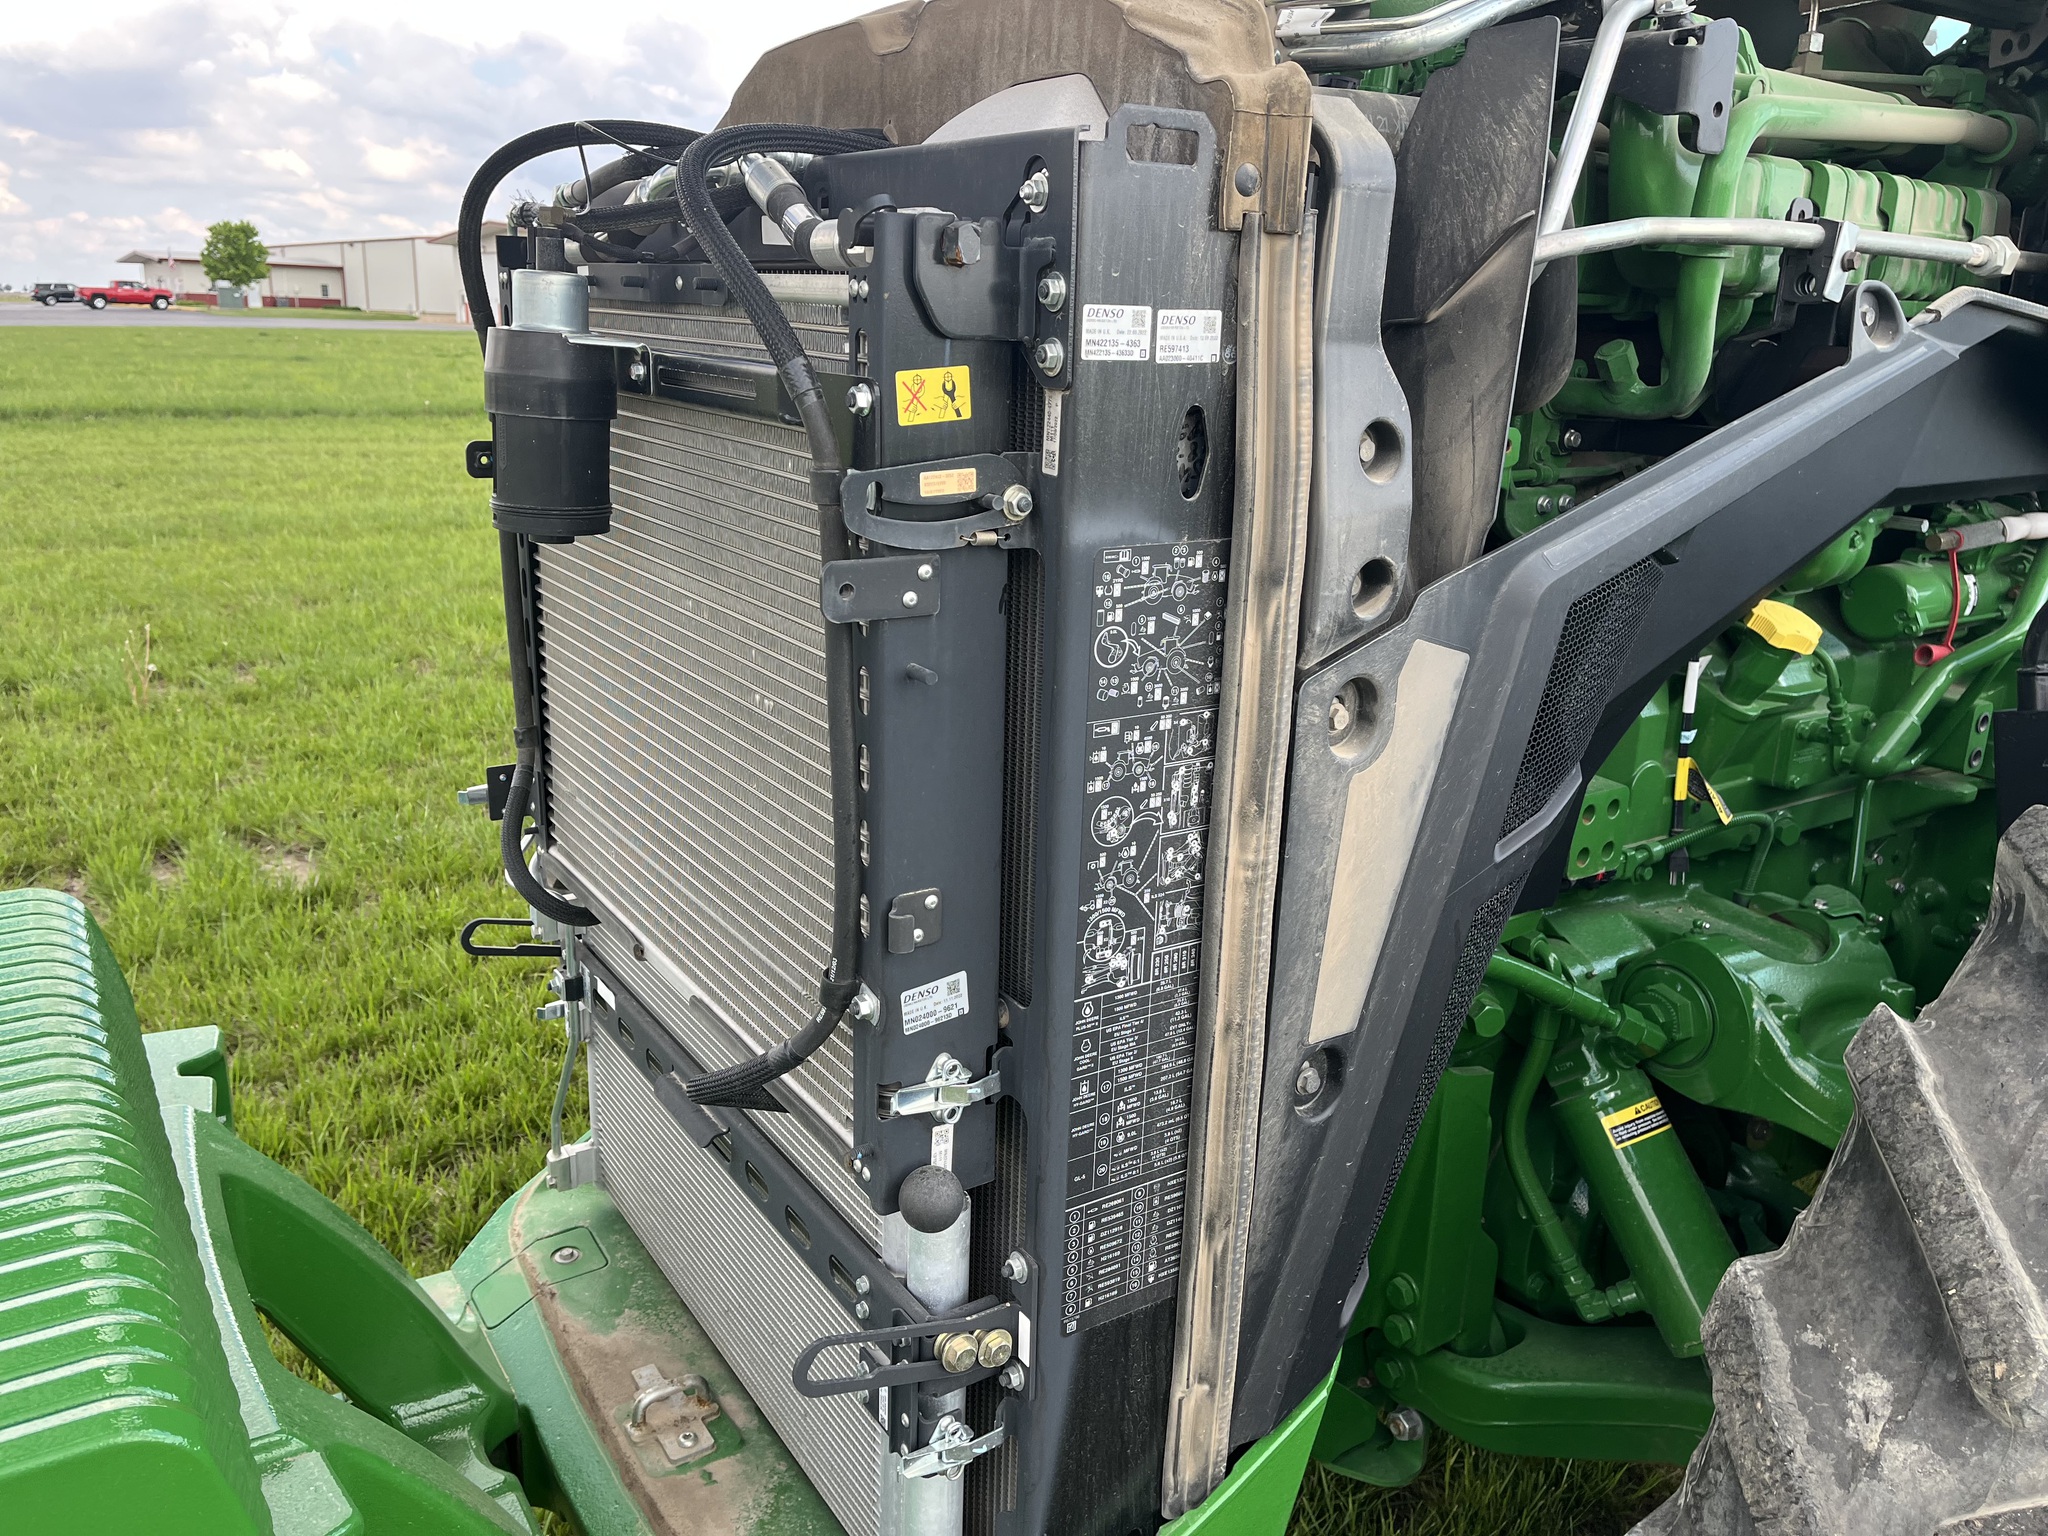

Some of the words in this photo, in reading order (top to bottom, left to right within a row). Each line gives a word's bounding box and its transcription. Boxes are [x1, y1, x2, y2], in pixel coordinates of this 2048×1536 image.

[1087, 308, 1124, 318] DENSO
[1161, 316, 1196, 325] DENSO
[903, 985, 939, 1004] DENSO
[1123, 1145, 1138, 1153] MFWD
